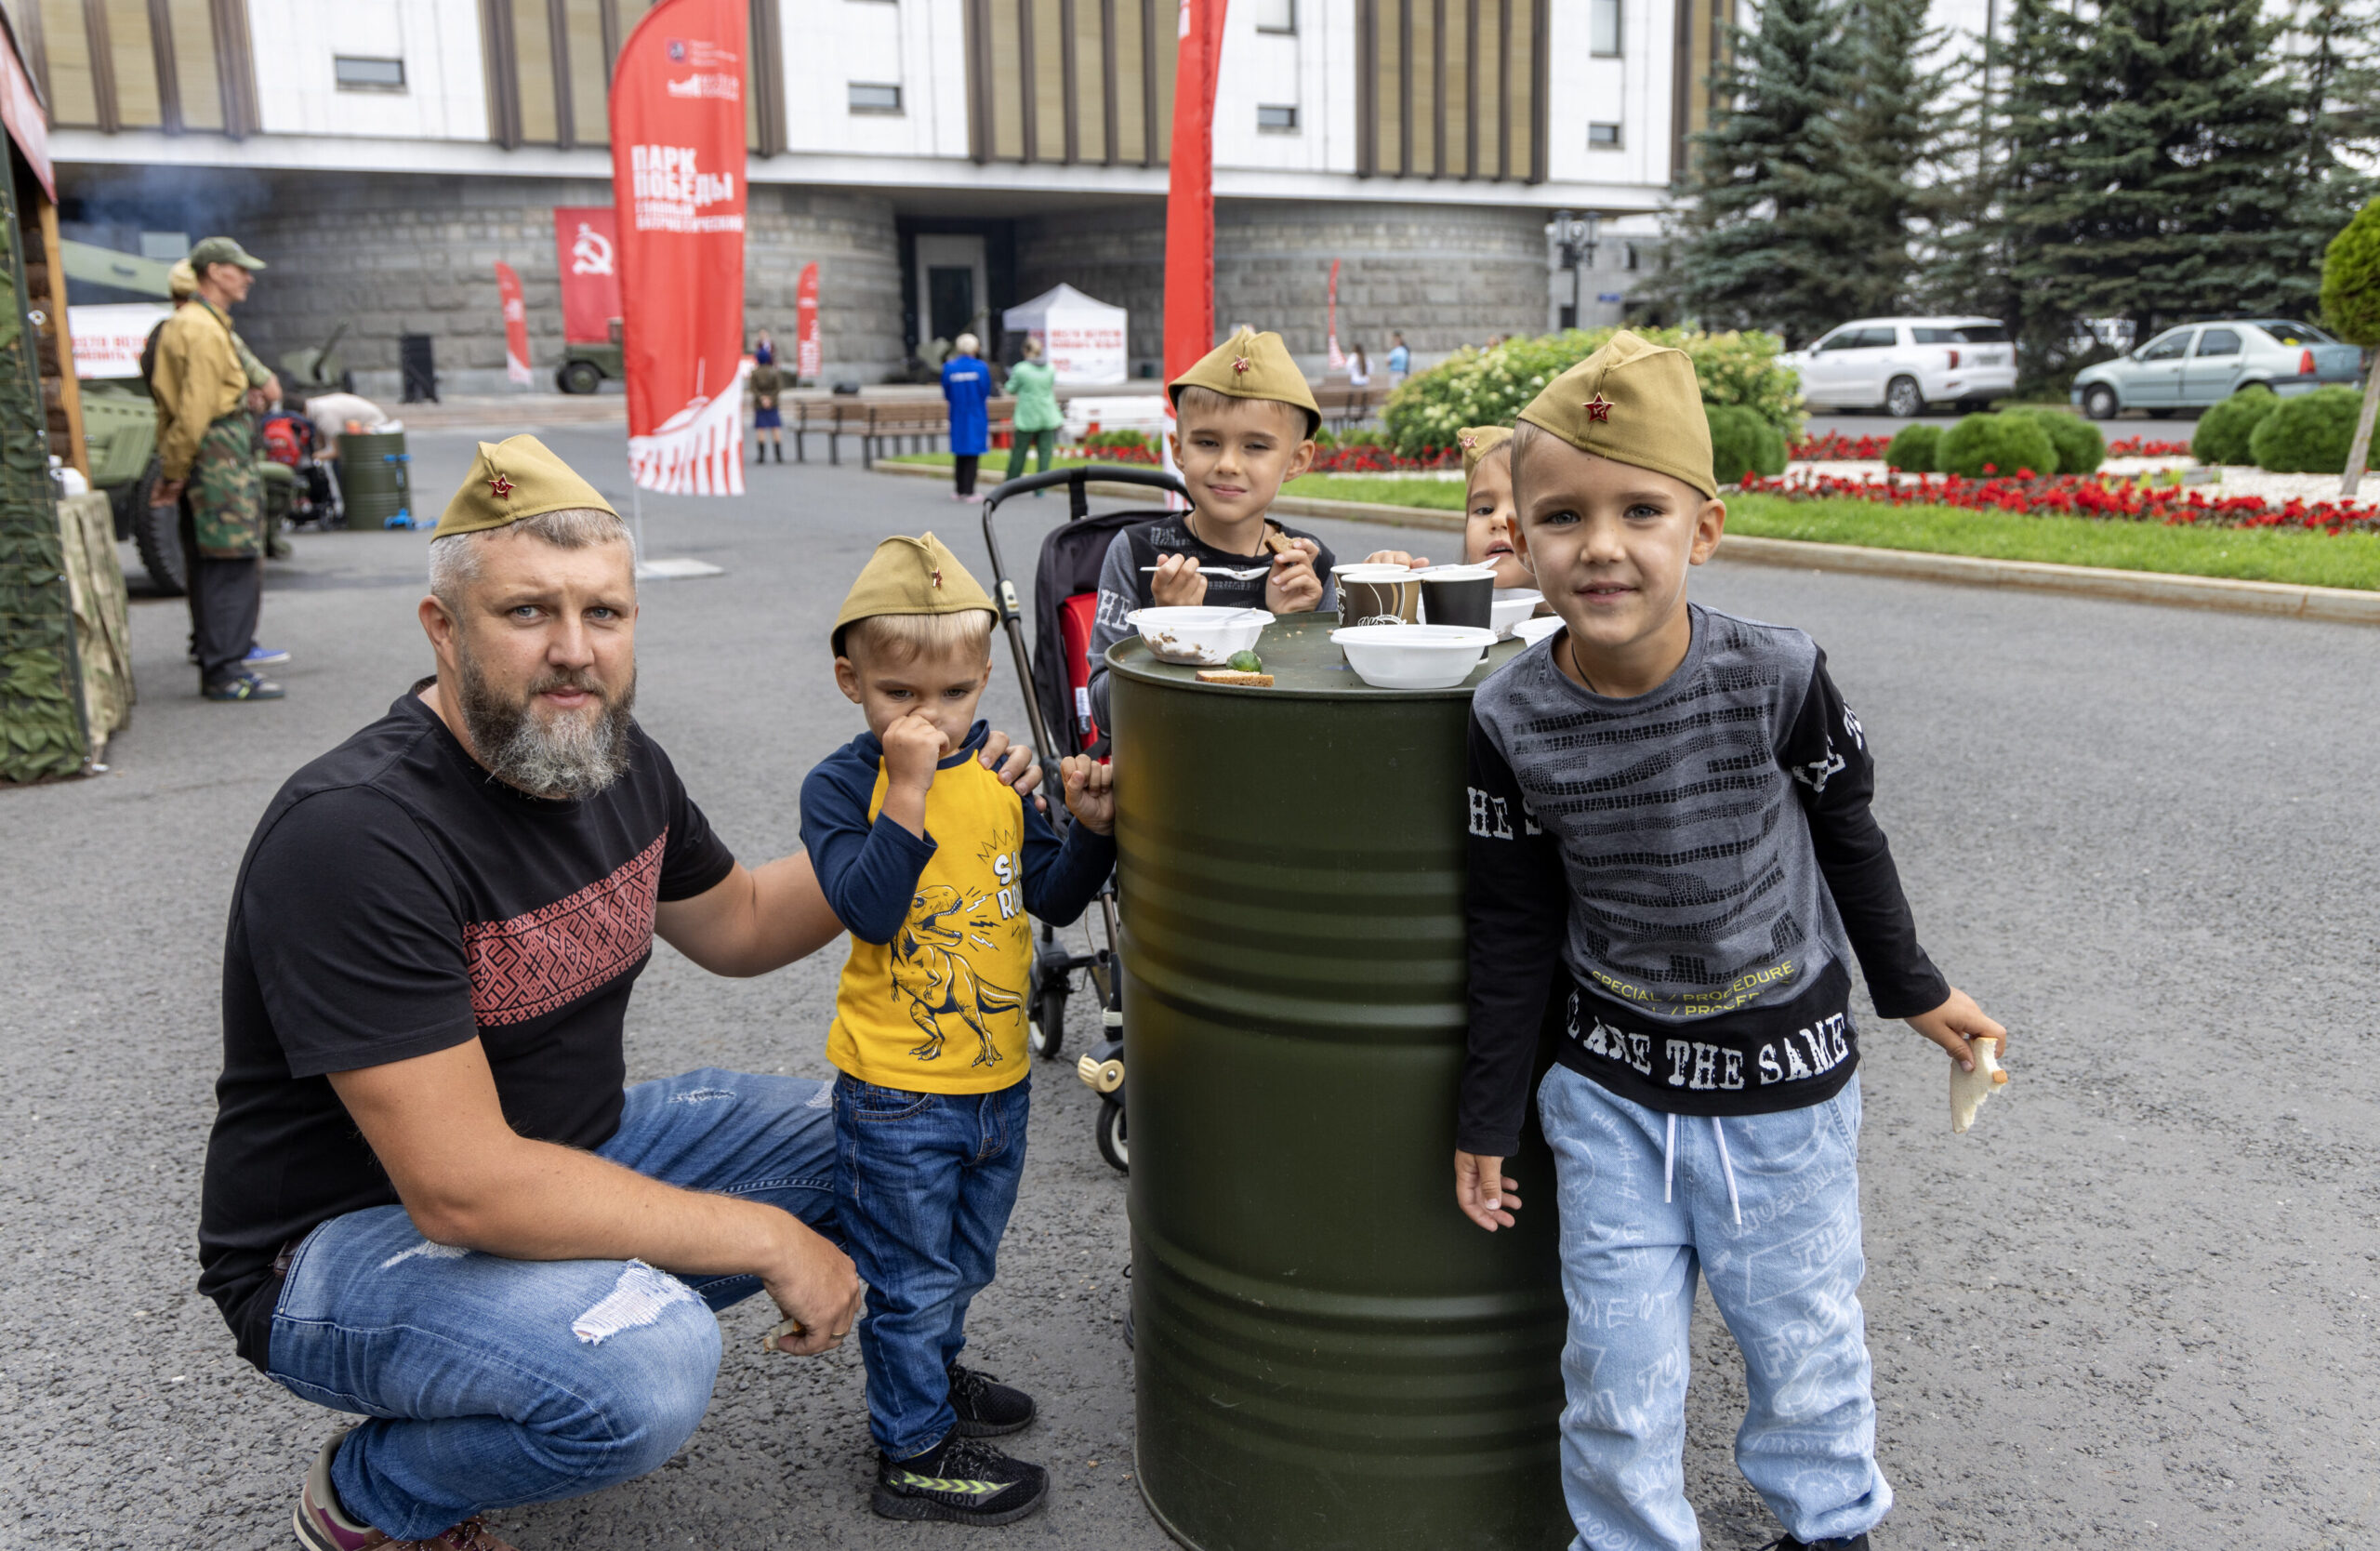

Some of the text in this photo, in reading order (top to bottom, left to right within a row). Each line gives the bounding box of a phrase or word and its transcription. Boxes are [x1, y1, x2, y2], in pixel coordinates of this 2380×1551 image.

[631, 144, 697, 173] ПАРК
[633, 171, 734, 206] ПОБЕДЫ
[1592, 970, 1662, 1001] SPECIAL
[1683, 960, 1795, 1002] PROCEDURE
[1583, 1014, 1652, 1077] ARE
[1665, 1039, 1744, 1091] THE
[1758, 1012, 1851, 1086] SAME
[906, 1485, 977, 1506] FASHION
